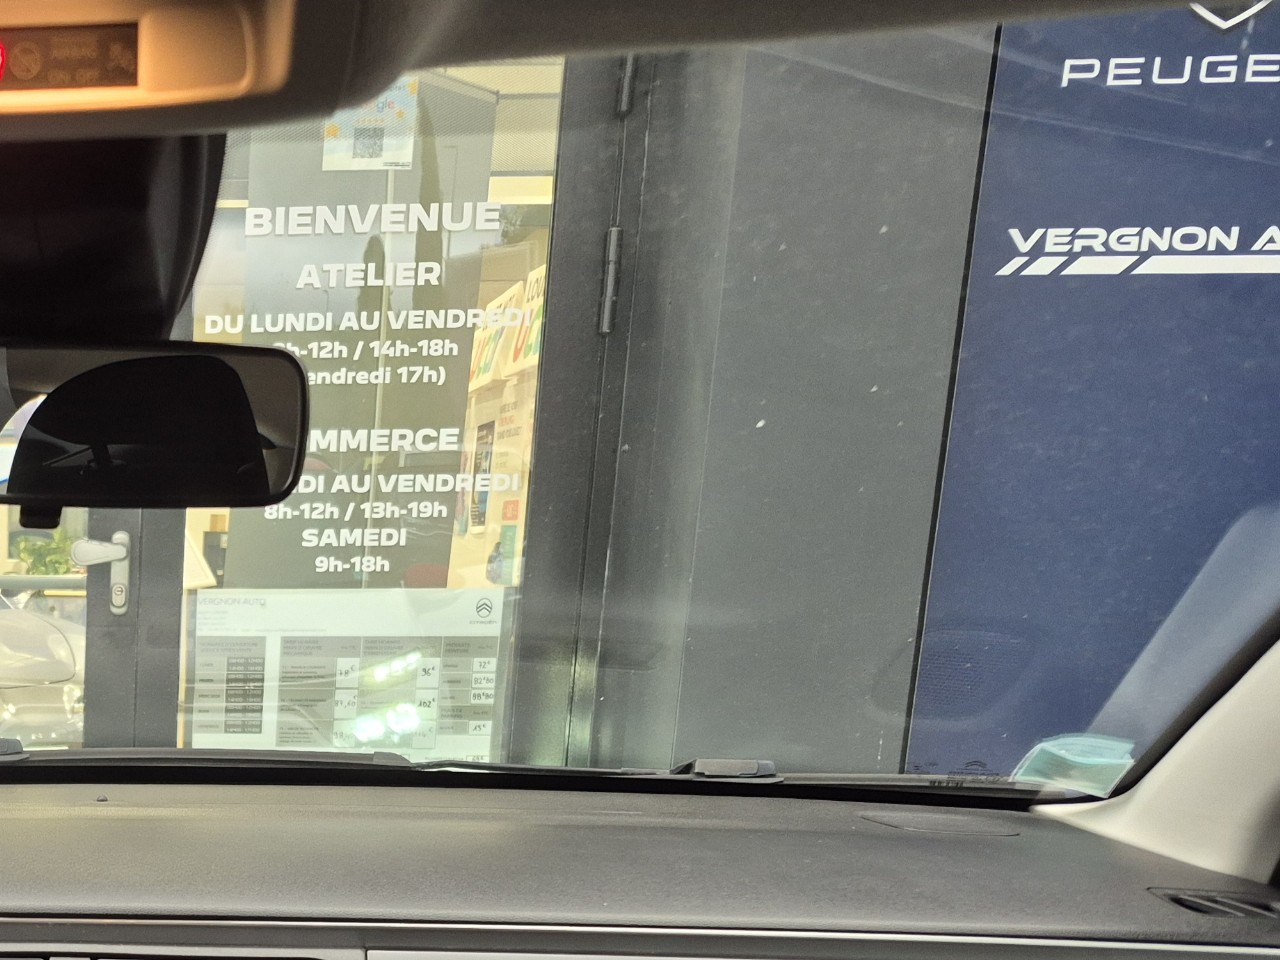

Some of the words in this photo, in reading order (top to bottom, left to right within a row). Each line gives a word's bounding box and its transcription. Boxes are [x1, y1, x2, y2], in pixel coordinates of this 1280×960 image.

[244, 202, 502, 237] BIENVENUE
[1007, 226, 1240, 254] VERGNON
[295, 261, 442, 289] ATELIER
[204, 314, 244, 334] DU
[250, 312, 333, 333] LUNDI
[338, 311, 381, 331] AU
[387, 308, 532, 330] VENDREDI
[352, 340, 364, 361] /
[368, 339, 459, 358] 14h-18h
[306, 366, 392, 386] endredi
[396, 365, 446, 386] 17h)
[308, 427, 460, 453] MMERCE
[330, 474, 372, 494] AU
[378, 473, 519, 493] VENDREDI
[263, 502, 340, 521] 8h-12h
[344, 501, 356, 522] /
[359, 501, 448, 520] 13h-19h
[300, 527, 407, 548] SAMEDI
[314, 555, 391, 574] 9h-18h
